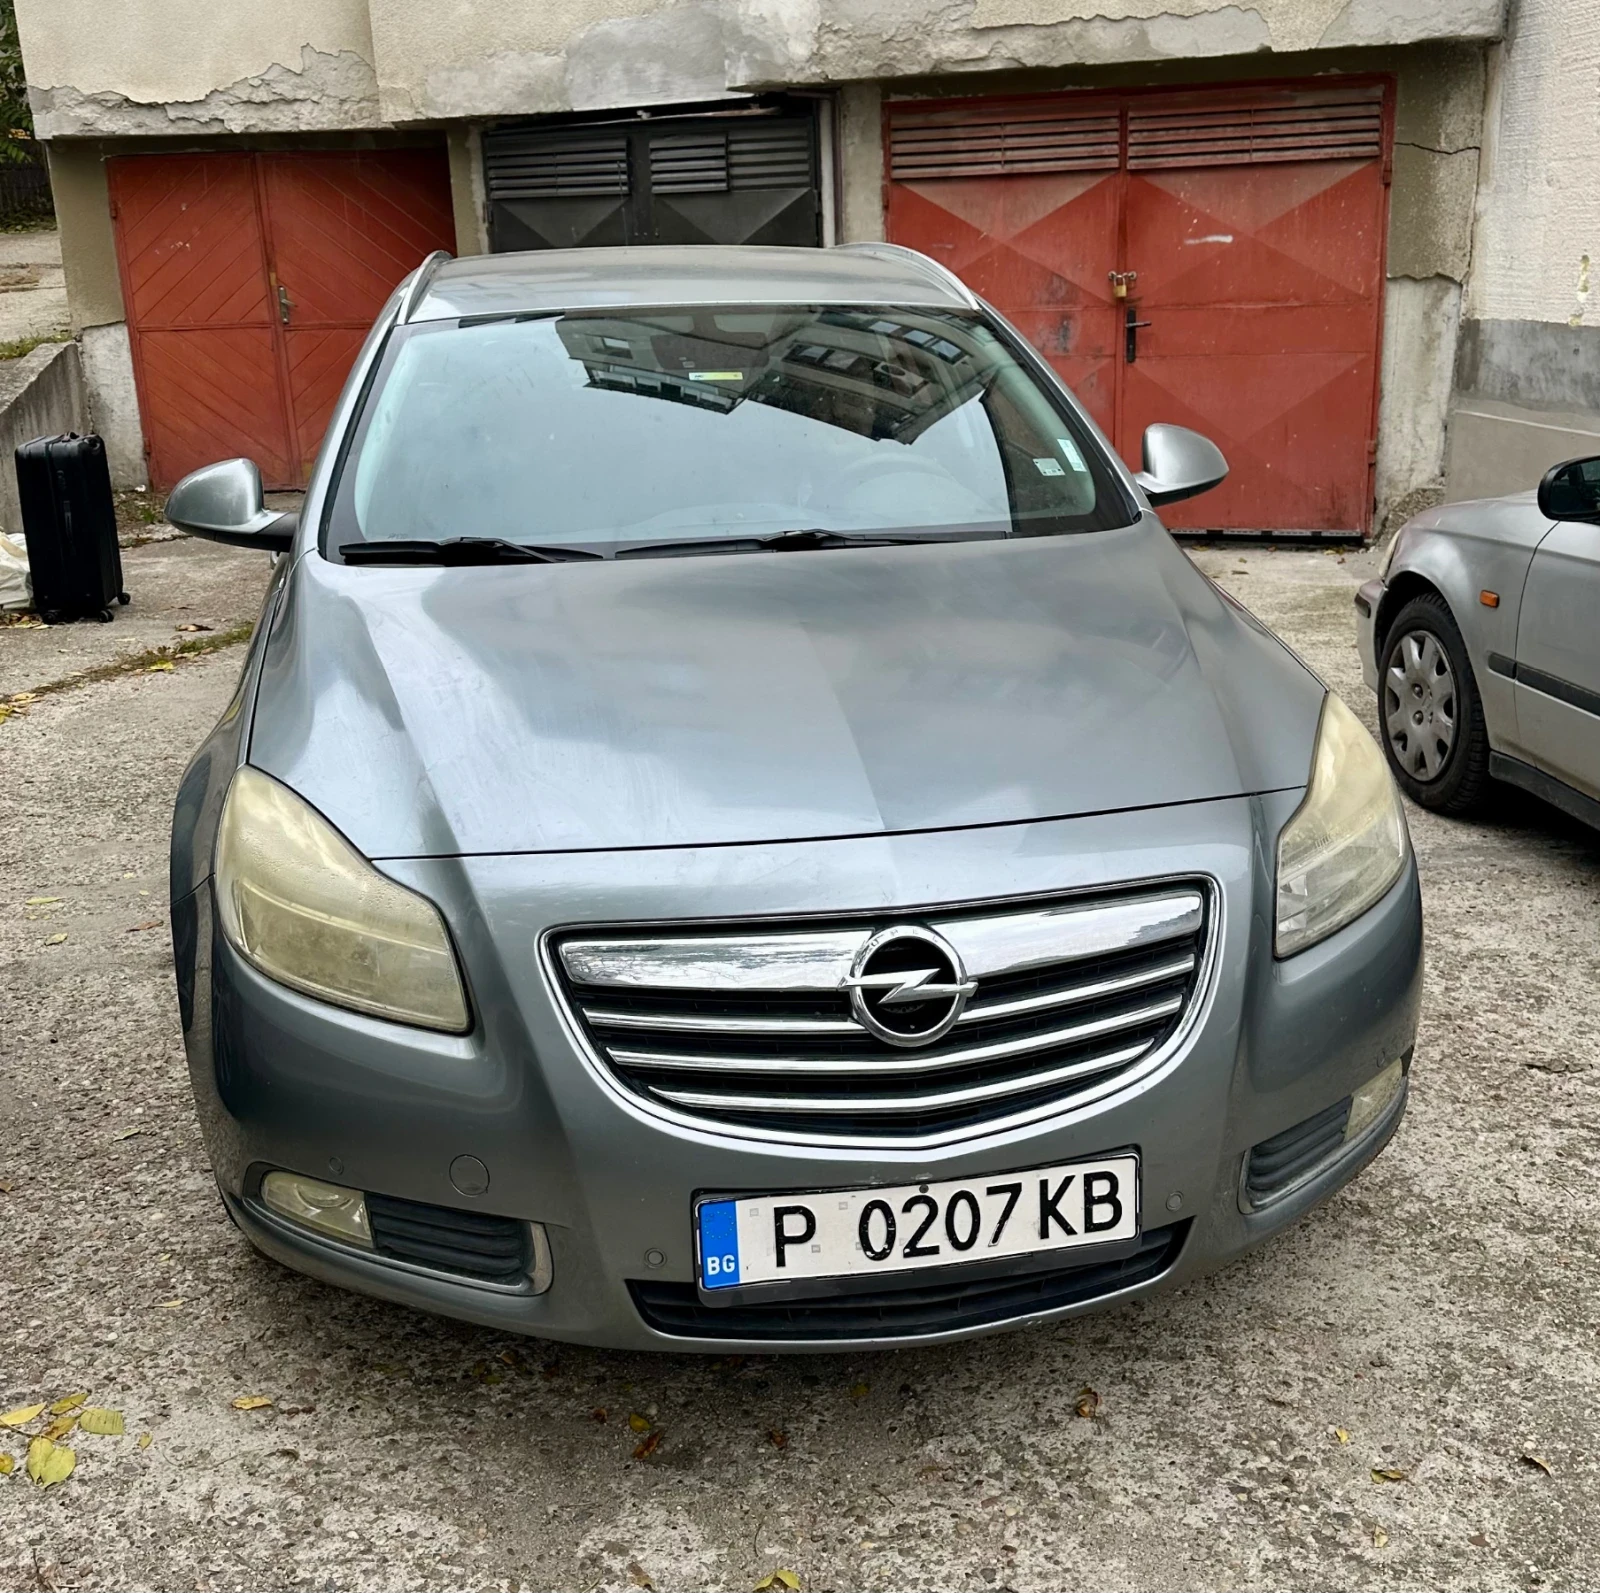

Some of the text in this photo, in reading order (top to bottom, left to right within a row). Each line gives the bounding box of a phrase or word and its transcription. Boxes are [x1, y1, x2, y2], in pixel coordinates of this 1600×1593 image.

[870, 928, 939, 947] OPEL
[773, 1205, 816, 1268] P
[858, 1183, 1023, 1262] 0207
[707, 1254, 736, 1275] BG
